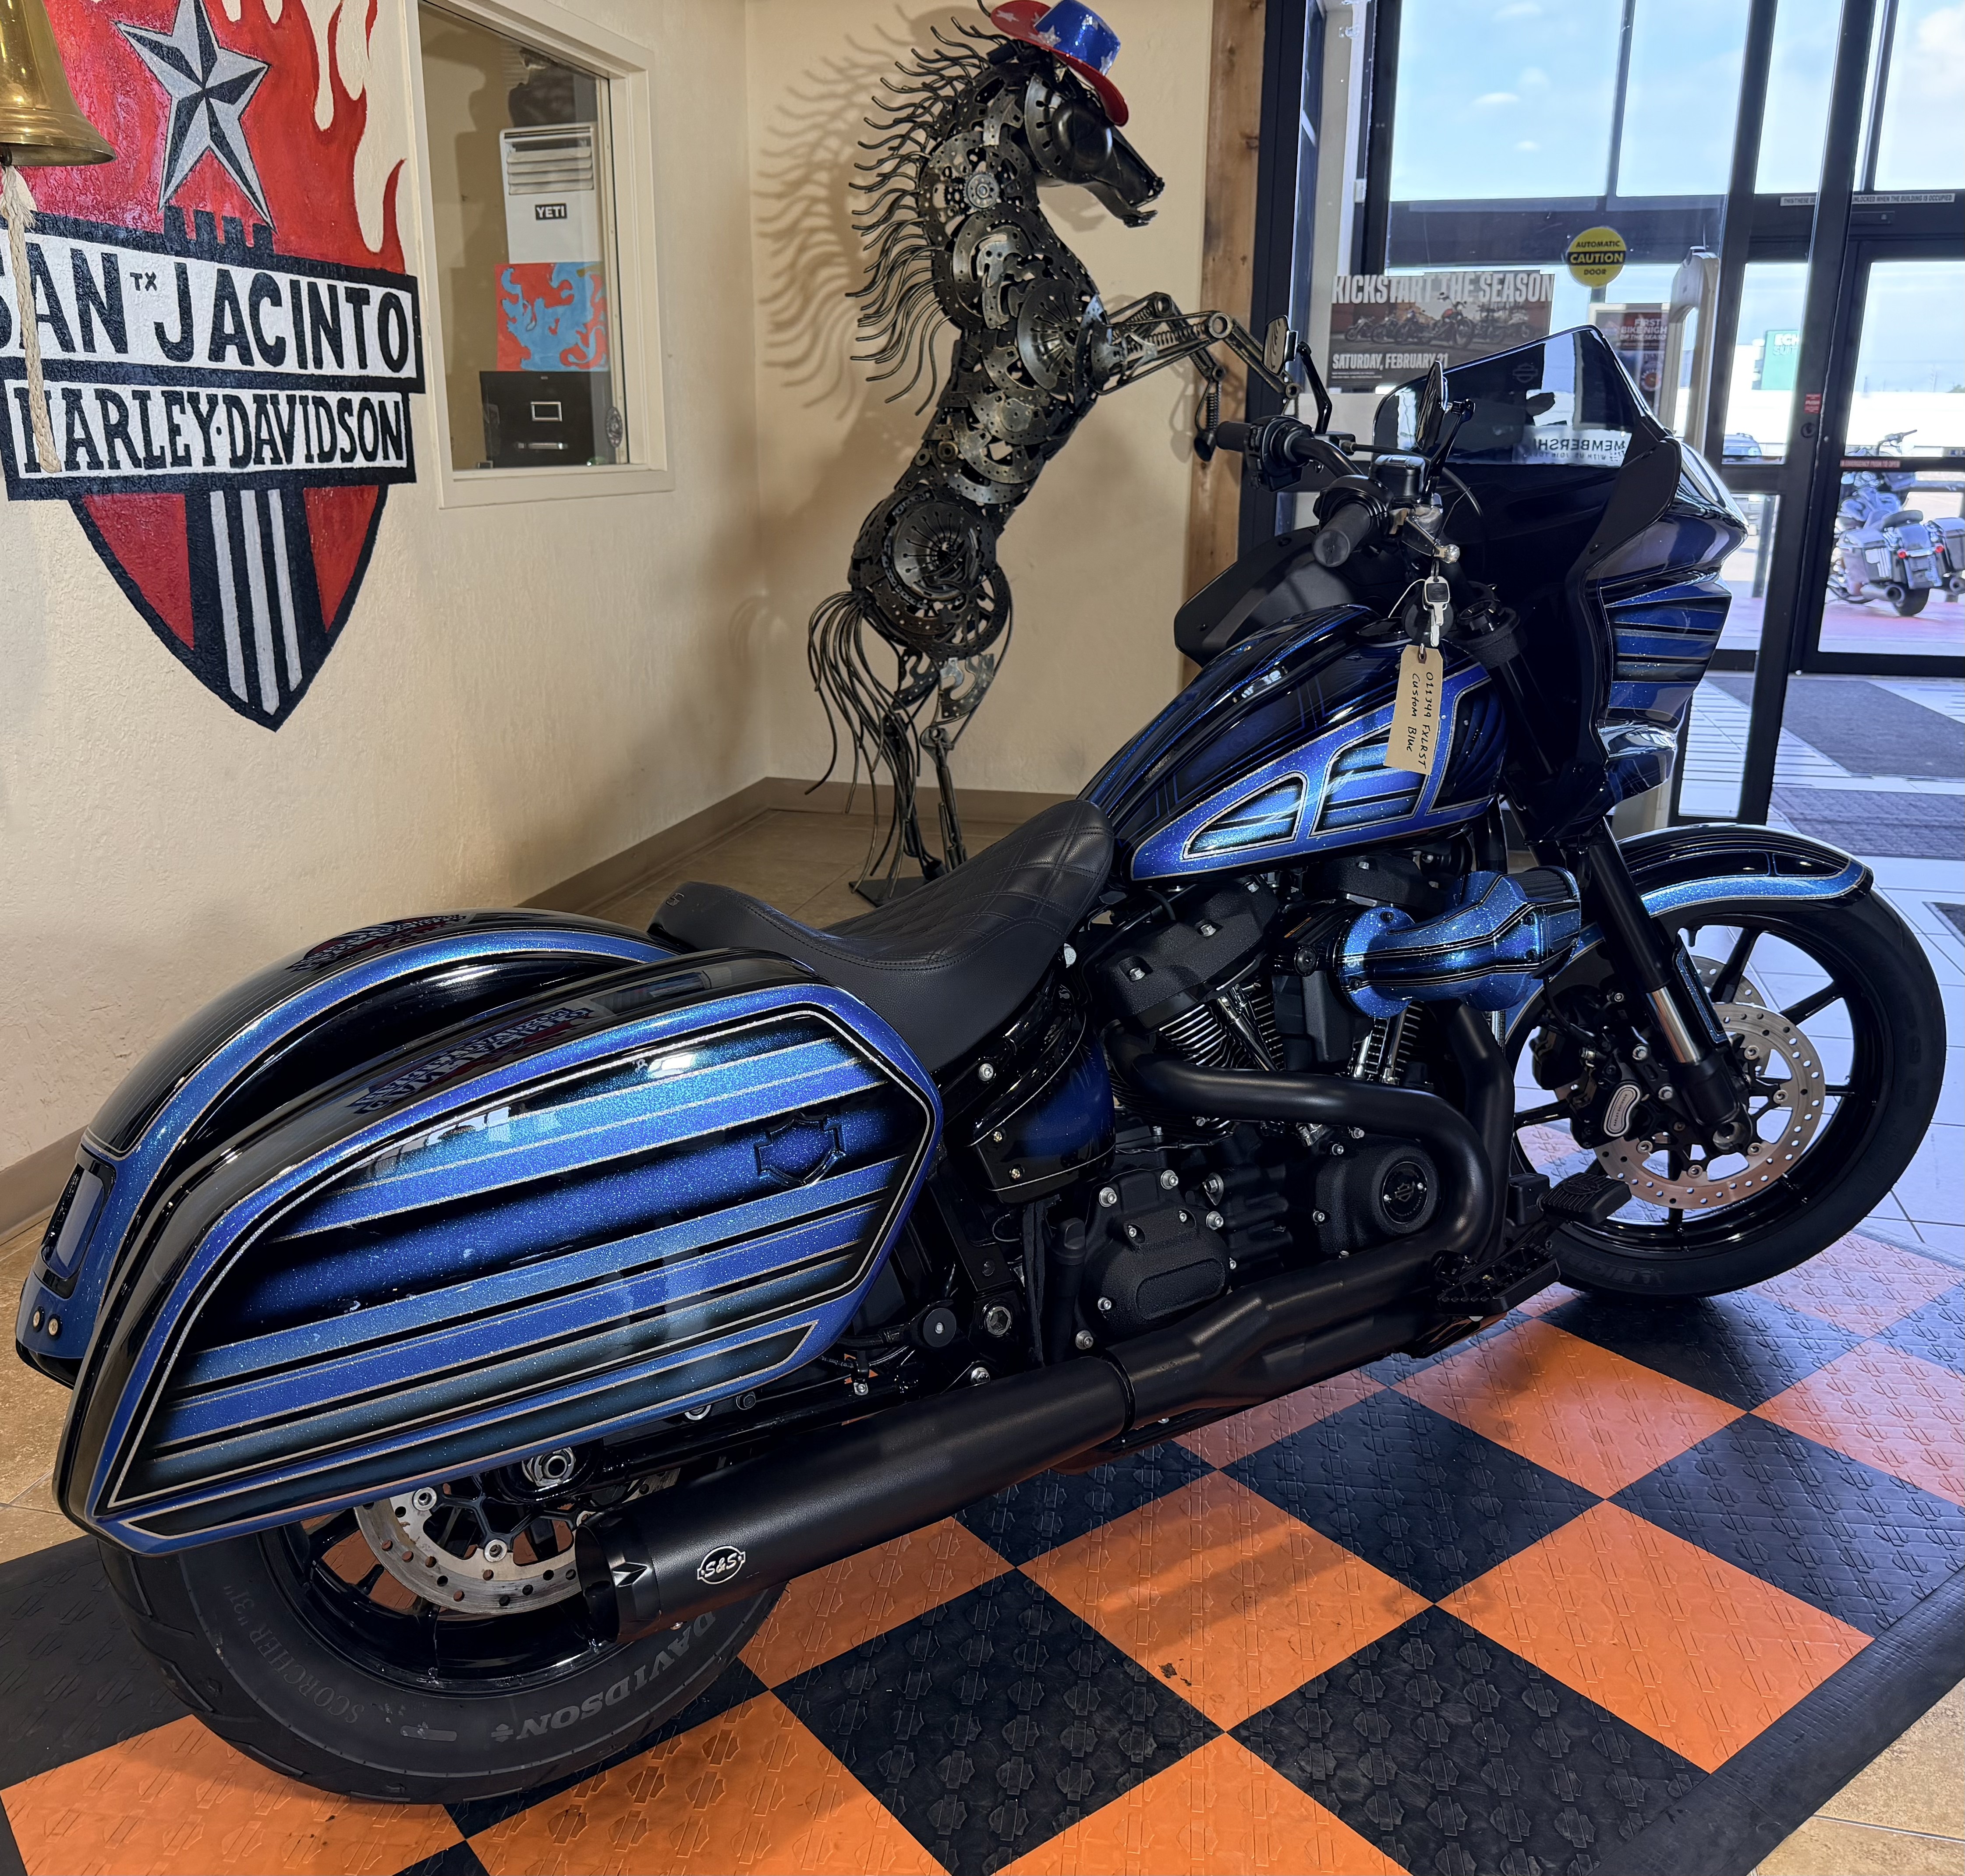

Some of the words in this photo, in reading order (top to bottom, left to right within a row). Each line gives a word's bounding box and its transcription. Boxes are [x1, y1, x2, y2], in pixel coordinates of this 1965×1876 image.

[536, 205, 566, 219] YETI
[1570, 253, 1624, 264] CAUTION
[1331, 274, 1434, 304] KICKSTART
[1440, 272, 1476, 304] THE
[1478, 272, 1554, 303] SEASON
[153, 261, 410, 372] JACINTO
[1621, 325, 1643, 334] BIKE
[1635, 318, 1661, 327] FIRST
[1332, 353, 1383, 371] SATURDAY,
[1385, 353, 1436, 369] FEBRUARY
[1423, 672, 1434, 717] 011349
[1418, 724, 1430, 769] FXLRST
[705, 1552, 737, 1578] S&S
[249, 1623, 366, 1726] SCORCHER
[516, 1611, 716, 1740] DAVIDSON
